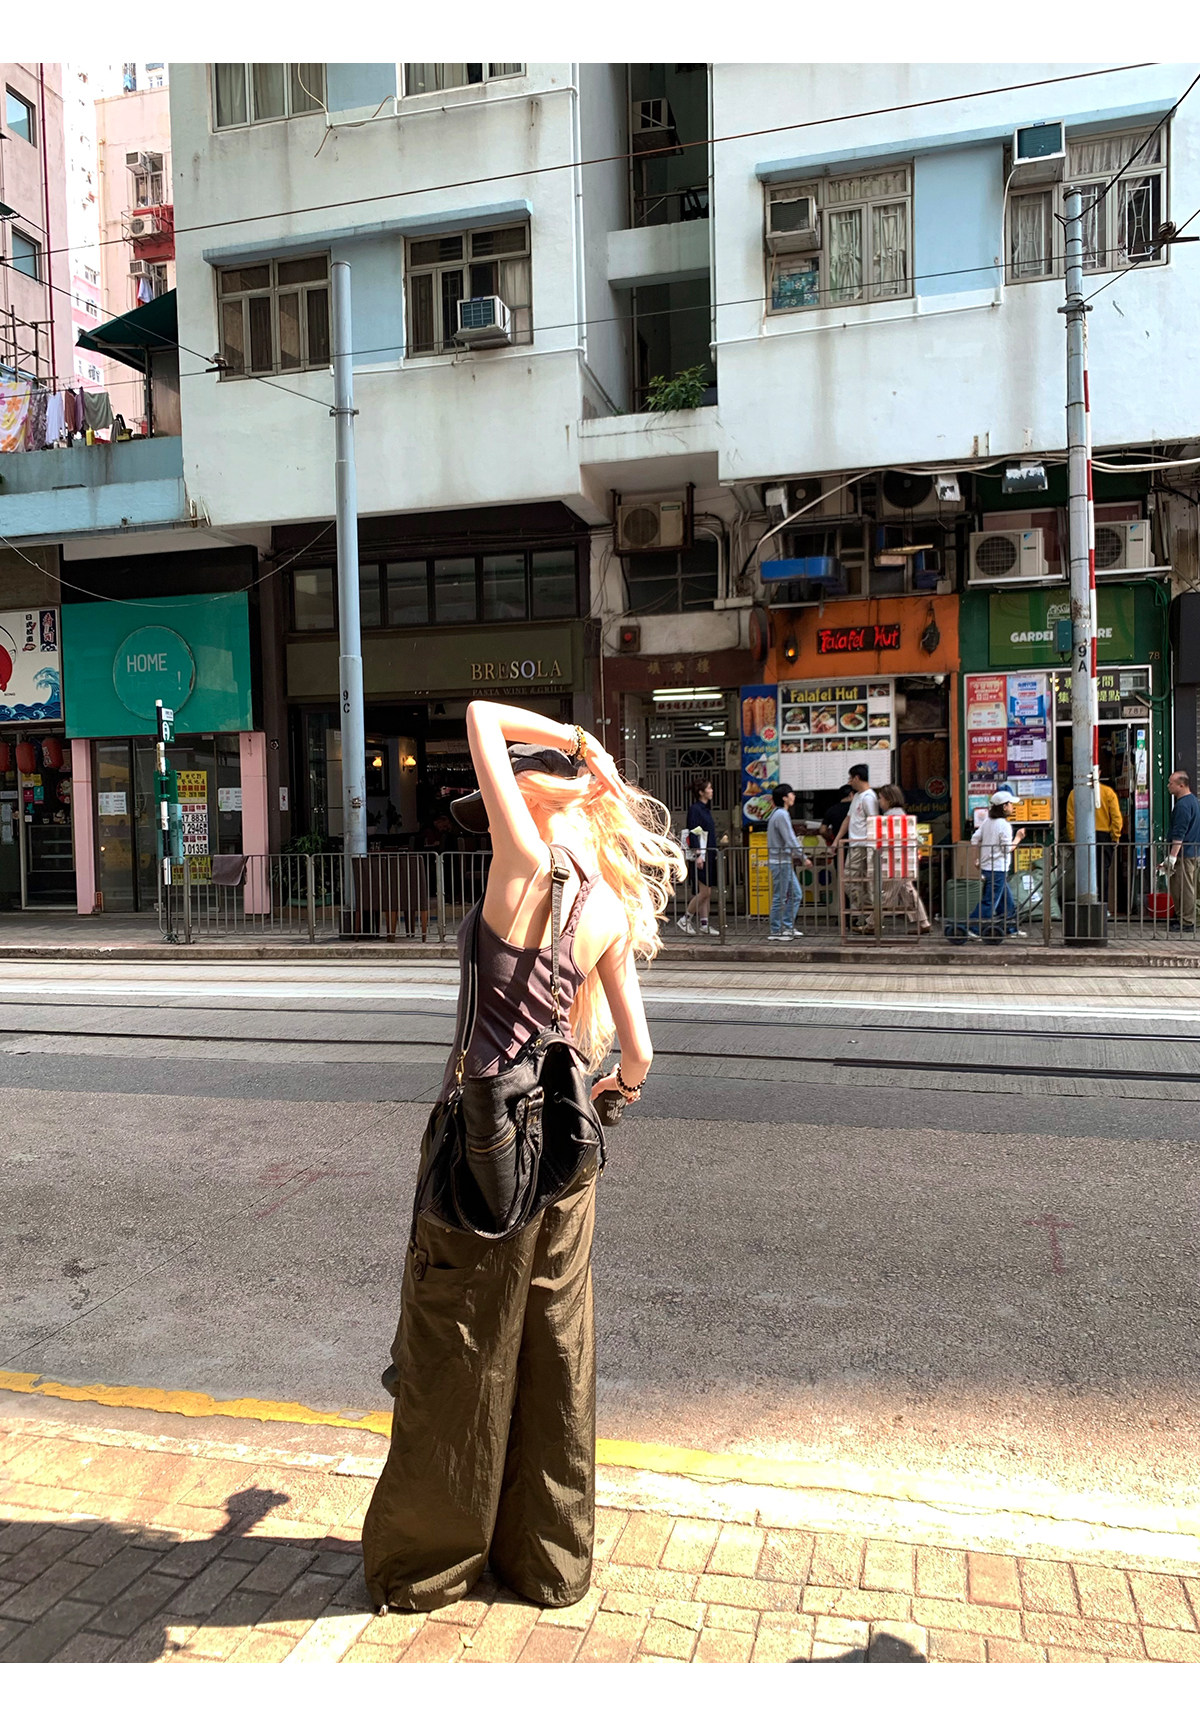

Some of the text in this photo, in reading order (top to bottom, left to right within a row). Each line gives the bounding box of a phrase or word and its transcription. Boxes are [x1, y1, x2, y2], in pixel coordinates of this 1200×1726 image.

[819, 625, 899, 653] Falafel Hut
[126, 653, 167, 673] HOME
[1148, 651, 1160, 660] 78
[471, 660, 562, 680] BRESOLA
[472, 688, 500, 697] PASTA
[503, 687, 527, 695] WINE
[790, 686, 859, 703] Falafel Hut
[191, 814, 206, 822] 8831
